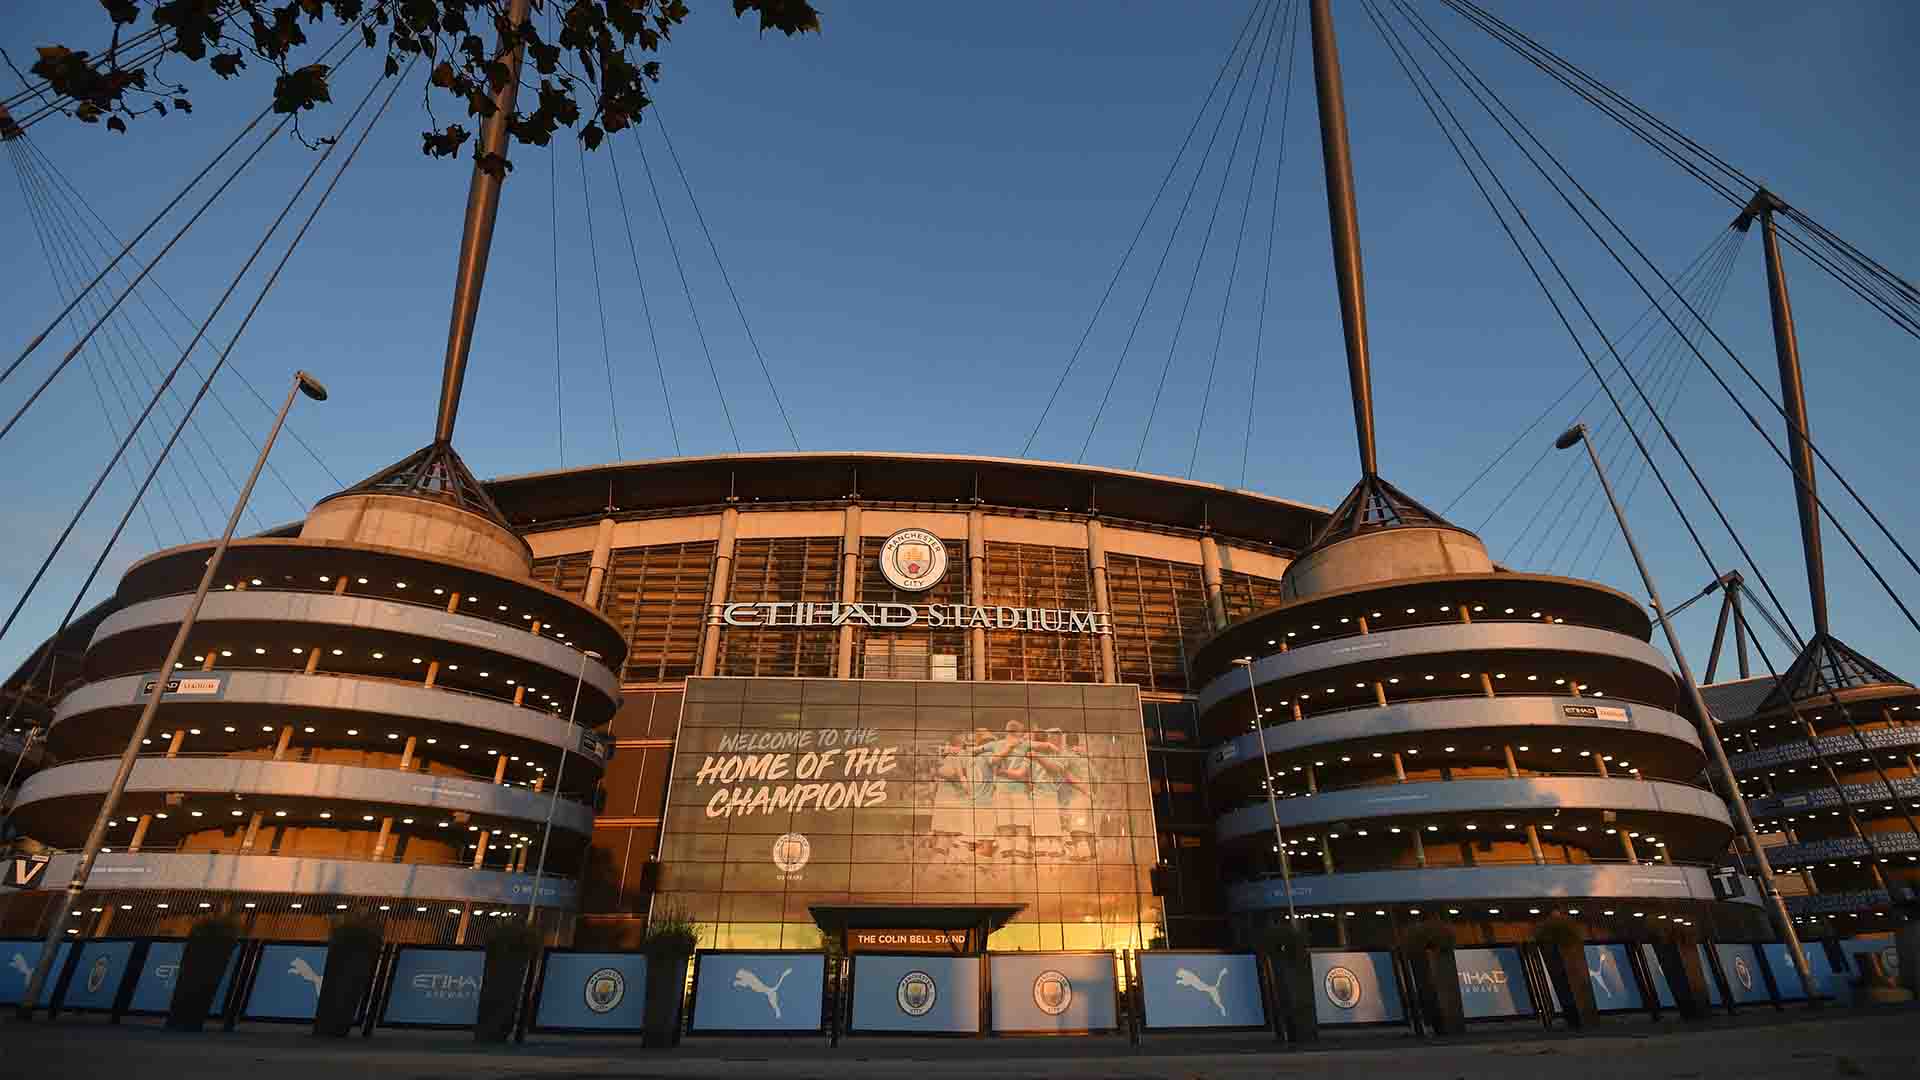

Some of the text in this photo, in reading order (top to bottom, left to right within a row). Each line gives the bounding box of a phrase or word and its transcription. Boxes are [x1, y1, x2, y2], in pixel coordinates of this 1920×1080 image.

[887, 532, 941, 553] MANCHESTER
[903, 579, 924, 587] CITY
[723, 602, 1098, 633] ETIHAD STADIUM
[719, 727, 881, 752] WELCOME TO THE
[696, 745, 899, 786] HOME OF THE
[705, 778, 888, 818] CHAMPIONS
[16, 859, 46, 885] V
[1713, 872, 1733, 895] T
[857, 935, 876, 944] THE
[878, 935, 907, 944] COLIN
[909, 935, 933, 944] BELL
